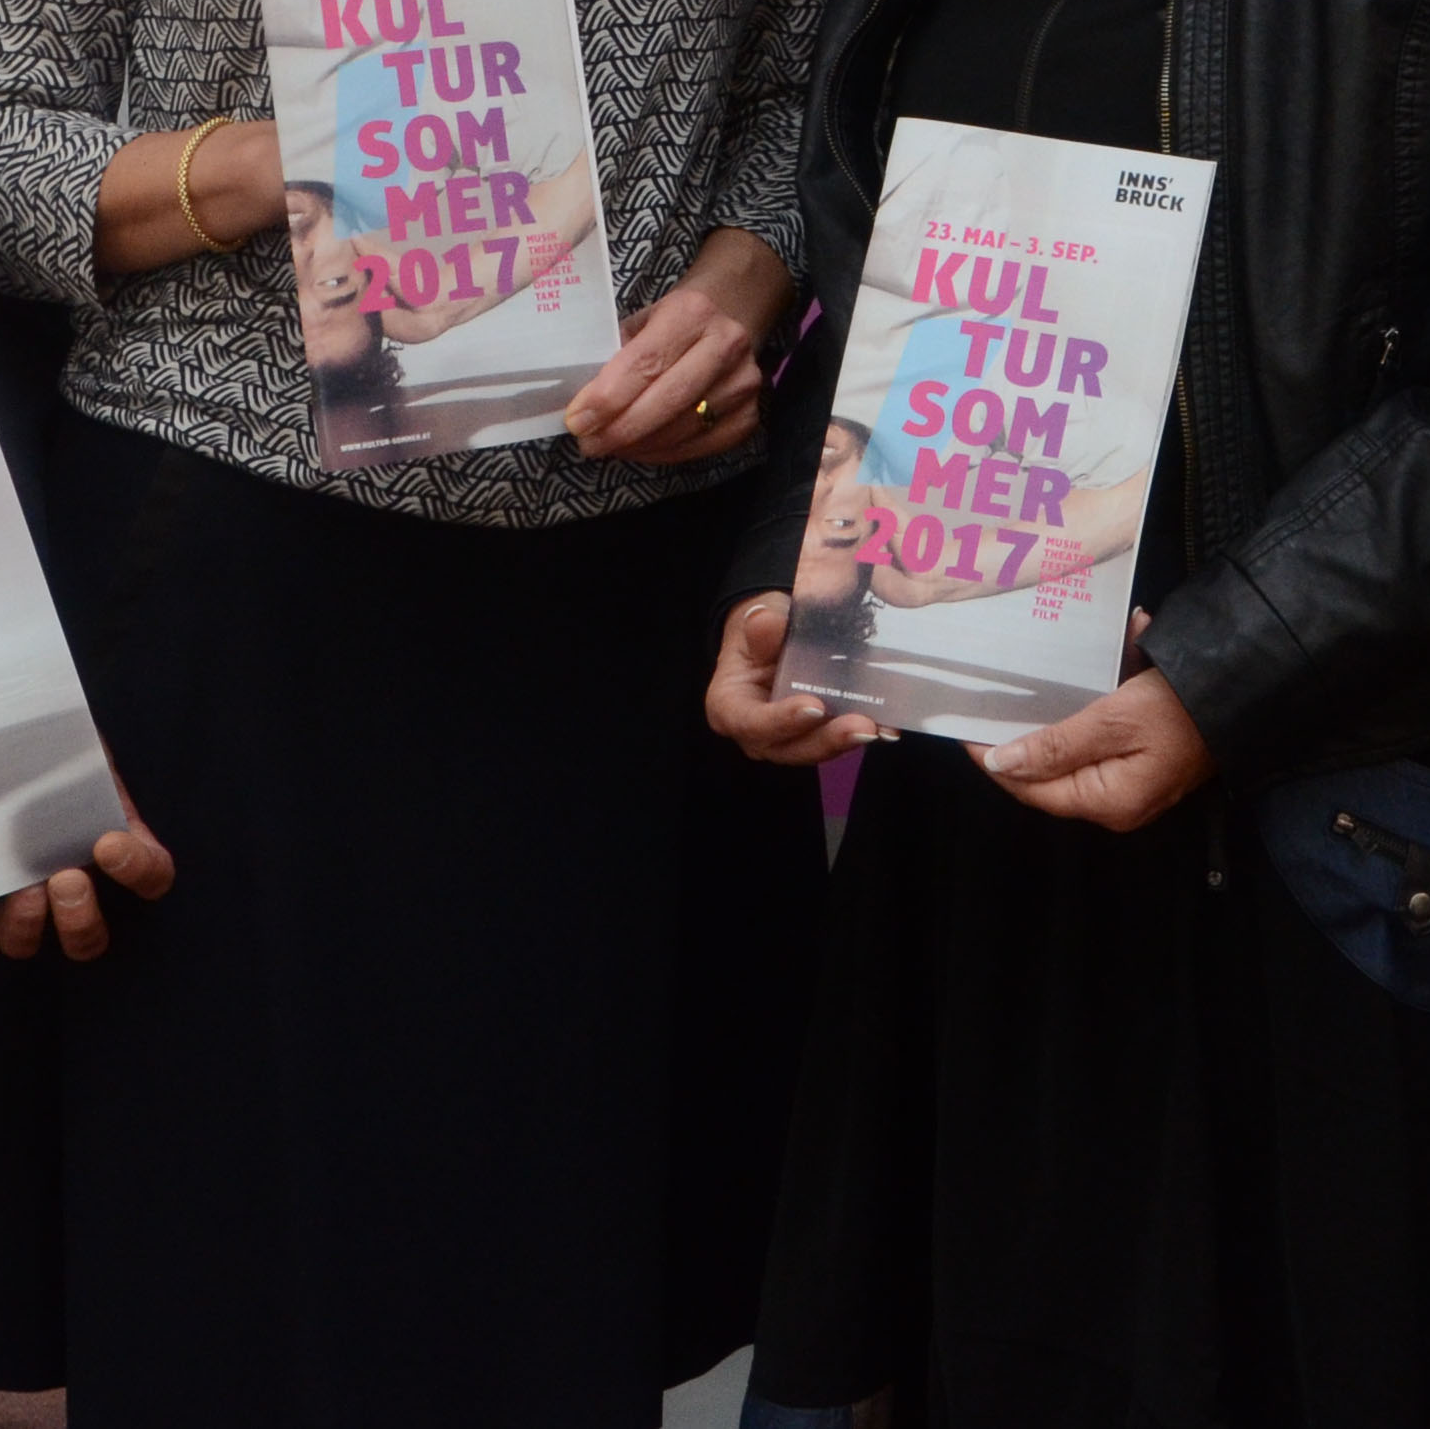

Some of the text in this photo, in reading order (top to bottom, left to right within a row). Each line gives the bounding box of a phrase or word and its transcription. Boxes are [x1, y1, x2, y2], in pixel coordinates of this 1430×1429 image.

[381, 40, 527, 109] TUR
[356, 106, 511, 179] SOM
[383, 170, 537, 242] MER
[1114, 187, 1185, 212] BRUCK
[1118, 170, 1174, 193] INNS'
[352, 236, 521, 315] 2017
[925, 221, 958, 243] 23.
[963, 226, 1007, 251] MAI
[1025, 235, 1045, 256] 3.
[1051, 240, 1099, 265] SEP.
[537, 302, 561, 313] FILM
[910, 247, 1060, 325] KUL
[959, 320, 1109, 399] TUR
[901, 380, 1072, 459] SOM
[907, 447, 1072, 528] MER
[854, 506, 1040, 588] 2017
[1032, 608, 1059, 621] FILM
[1035, 596, 1063, 610] TANZ
